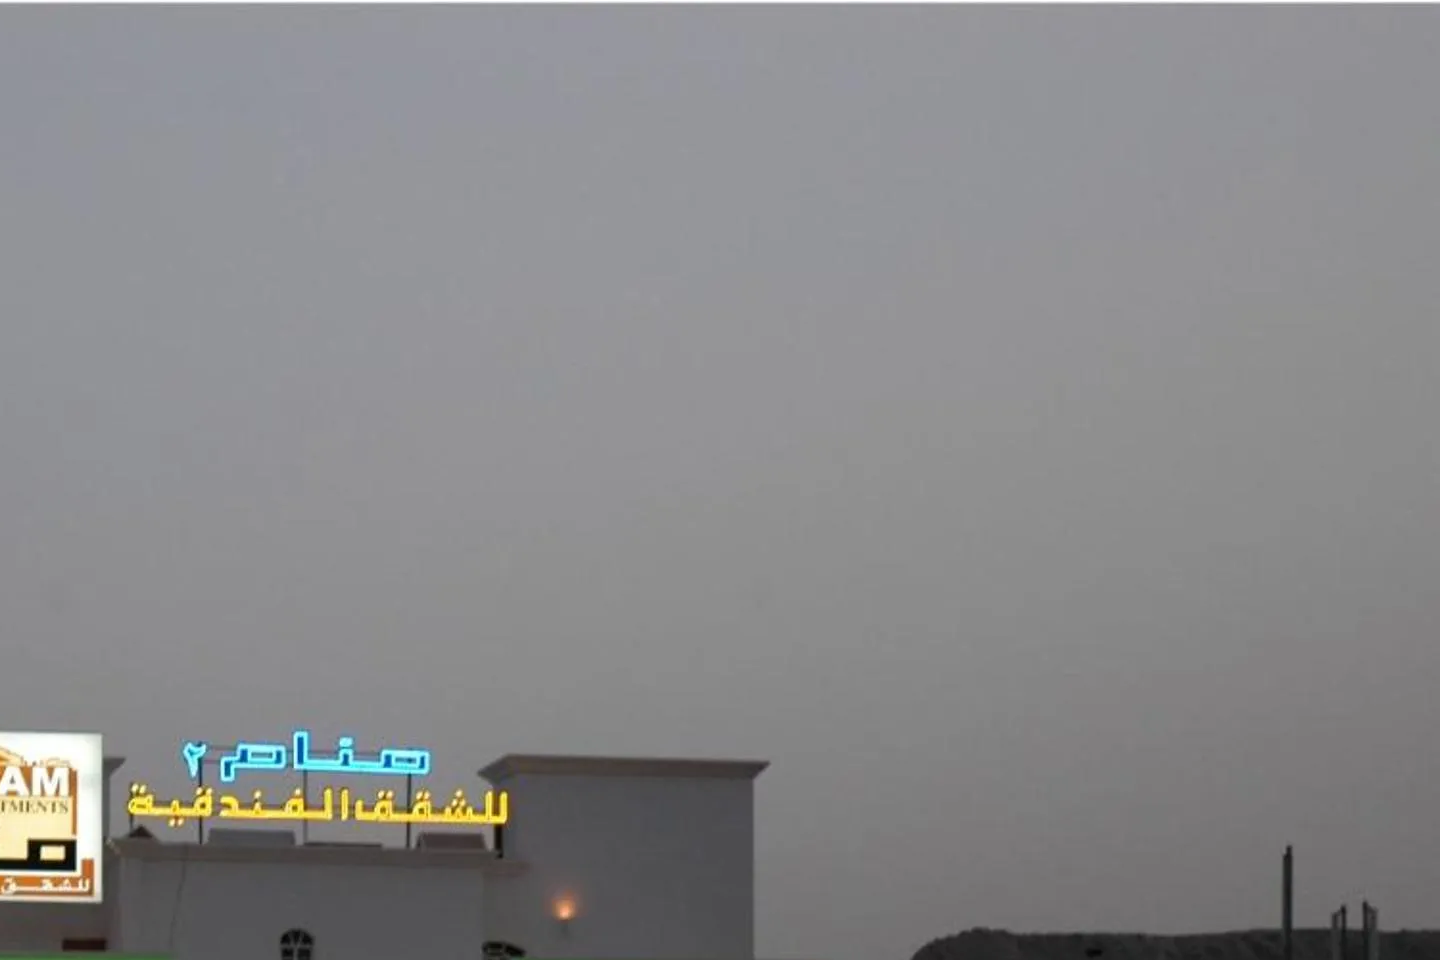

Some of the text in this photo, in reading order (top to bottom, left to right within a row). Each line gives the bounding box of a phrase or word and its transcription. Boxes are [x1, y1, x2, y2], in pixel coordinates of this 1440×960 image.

[219, 731, 430, 782] منام
[128, 783, 508, 827] للشقق الفندقية
